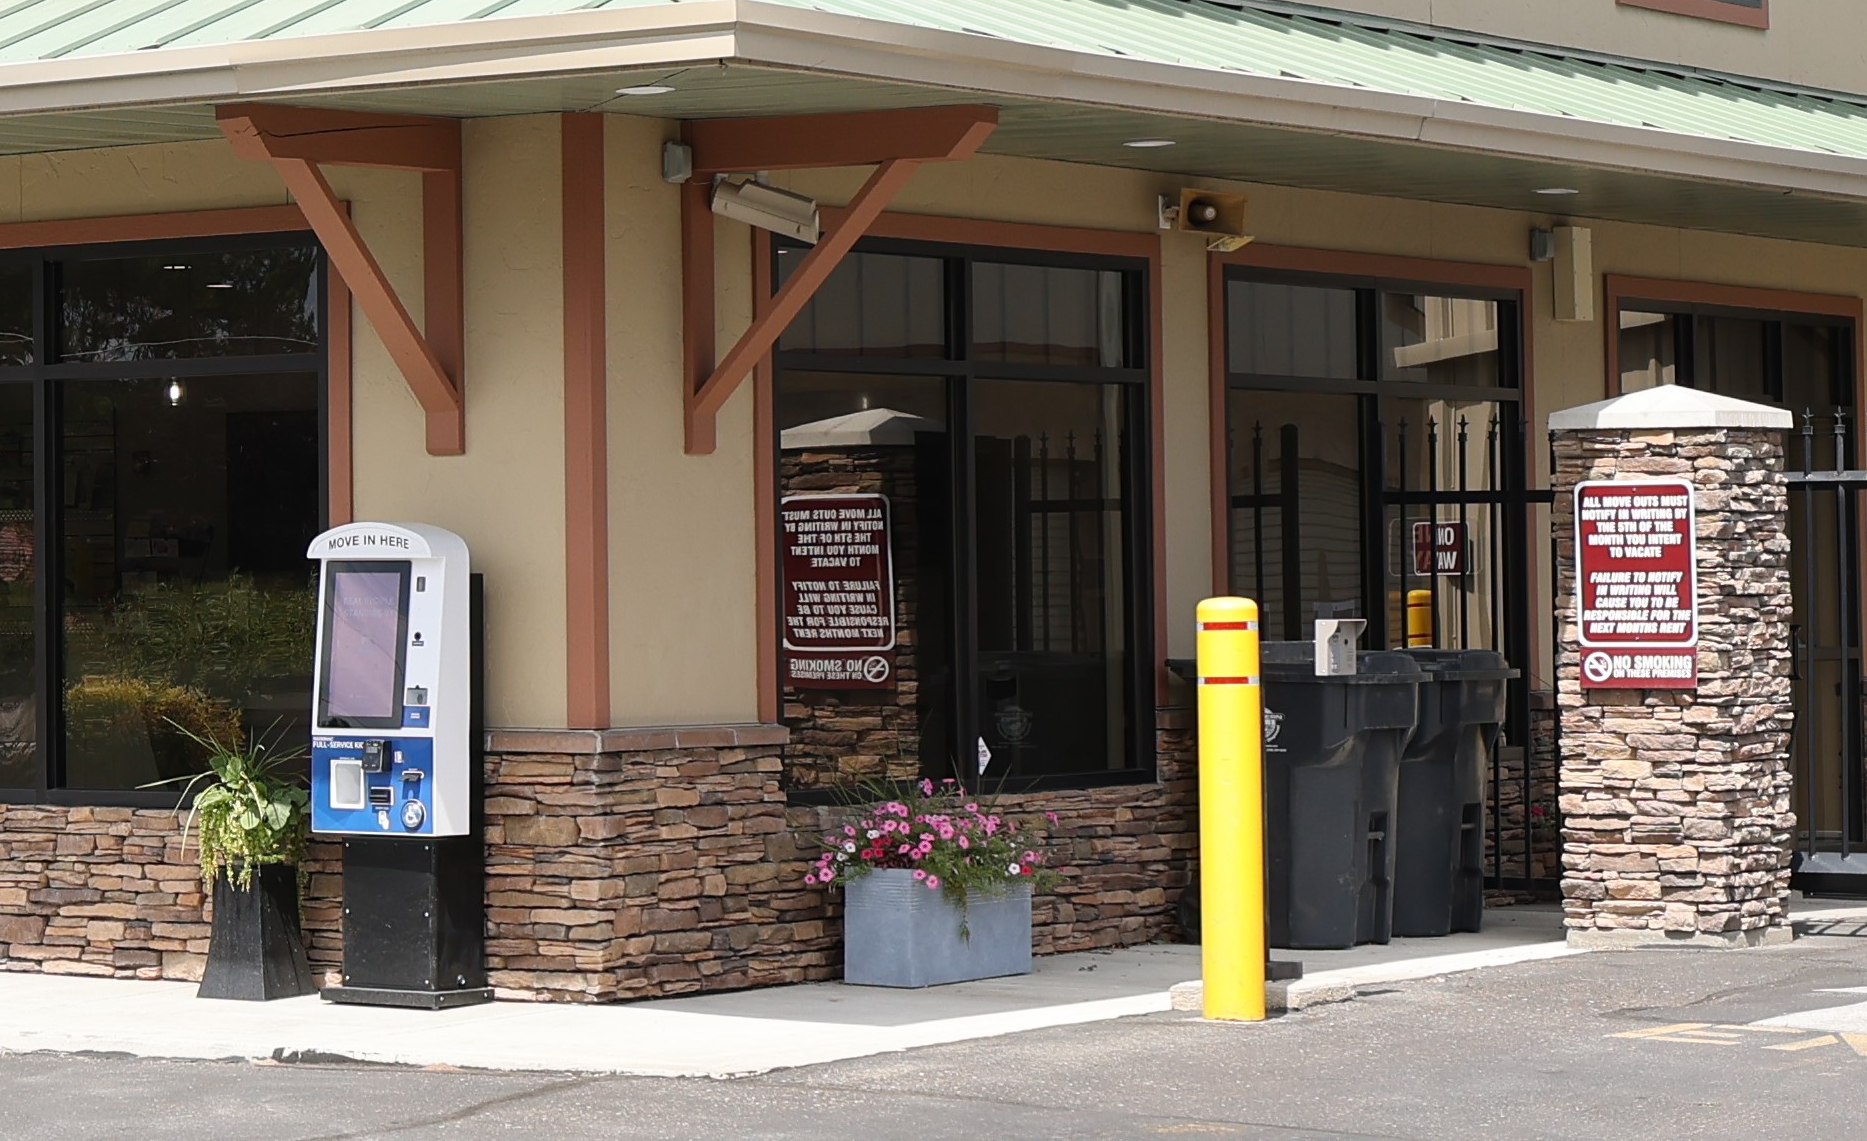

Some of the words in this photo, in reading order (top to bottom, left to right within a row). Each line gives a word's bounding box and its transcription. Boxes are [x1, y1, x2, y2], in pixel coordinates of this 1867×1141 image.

[1583, 496, 1601, 507] ALL
[1602, 496, 1632, 507] MOVE
[1633, 496, 1659, 507] OUTS
[1660, 495, 1688, 506] MUST
[1581, 509, 1617, 520] NOTIFY
[1618, 509, 1629, 520] IN
[1631, 508, 1672, 519] WRITING
[1674, 508, 1687, 519] BY
[1596, 521, 1616, 533] THE
[1618, 521, 1637, 532] 5TH
[1639, 521, 1652, 532] OF
[1654, 521, 1674, 532] THE
[328, 535, 359, 550] MOVE
[364, 534, 375, 545] IN
[380, 534, 409, 550] HERE
[1588, 534, 1624, 545] MONTH
[1625, 534, 1646, 545] YOU
[1648, 533, 1683, 545] INTENT
[1609, 546, 1623, 558] TO
[1624, 546, 1662, 558] VACATE
[1590, 571, 1631, 583] FAILURE
[1633, 571, 1646, 583] TO
[1647, 571, 1683, 583] NOTIFY
[1596, 584, 1608, 595] IN
[1609, 584, 1651, 595] WRITING
[1653, 584, 1677, 595] WILL
[1595, 597, 1627, 608] CAUSE
[1629, 597, 1649, 608] YOU
[1650, 597, 1664, 608] TO
[1664, 597, 1680, 608] BE
[1583, 610, 1649, 621] RESPONSIBLE
[1650, 610, 1671, 621] FOR
[1672, 610, 1692, 621] THE
[1589, 622, 1616, 634] NEXT
[1616, 622, 1658, 634] MONTHS
[1659, 622, 1687, 634] RENT
[1613, 655, 1632, 669] NO
[1633, 655, 1692, 669] SMOKING
[1613, 669, 1625, 678] ON
[1627, 669, 1651, 678] THESE
[1651, 669, 1692, 678] PREMISES
